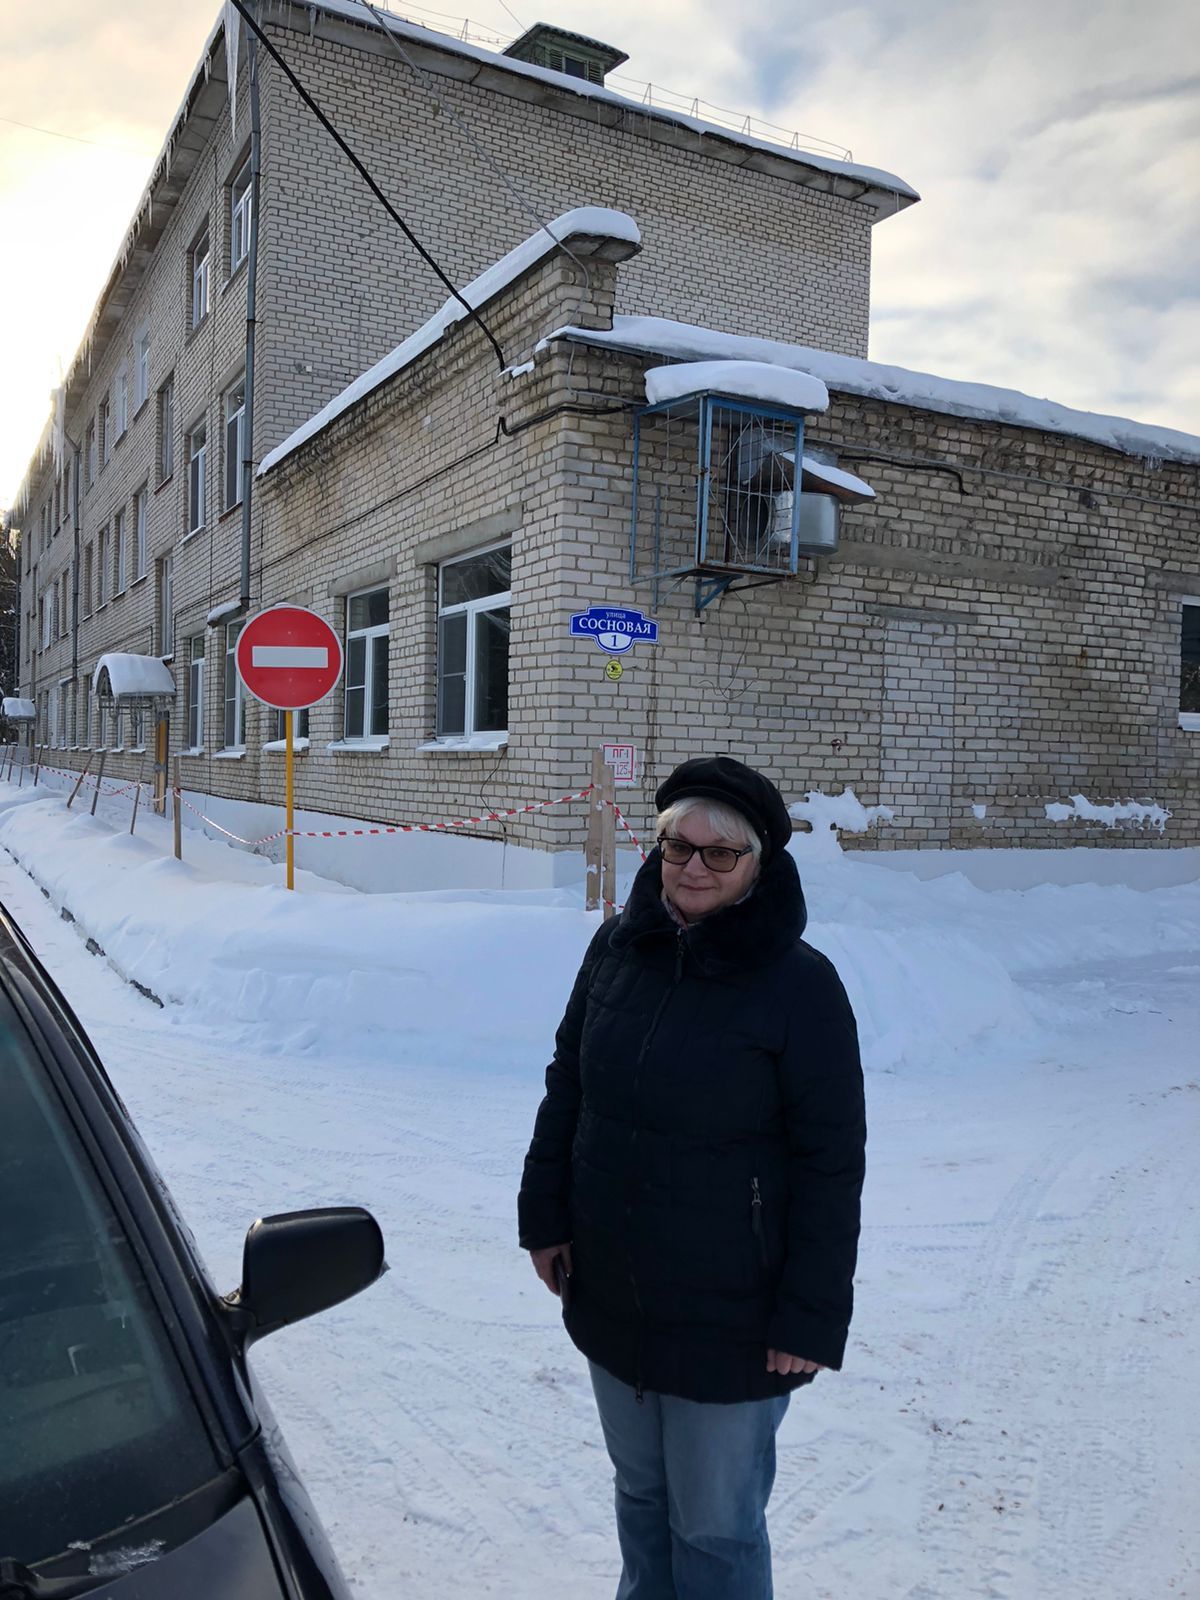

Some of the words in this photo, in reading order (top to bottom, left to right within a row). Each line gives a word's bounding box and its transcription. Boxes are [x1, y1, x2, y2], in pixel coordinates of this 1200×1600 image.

[605, 611, 626, 619] улица
[578, 617, 651, 634] СОСНОВАЯ
[611, 634, 617, 647] 1
